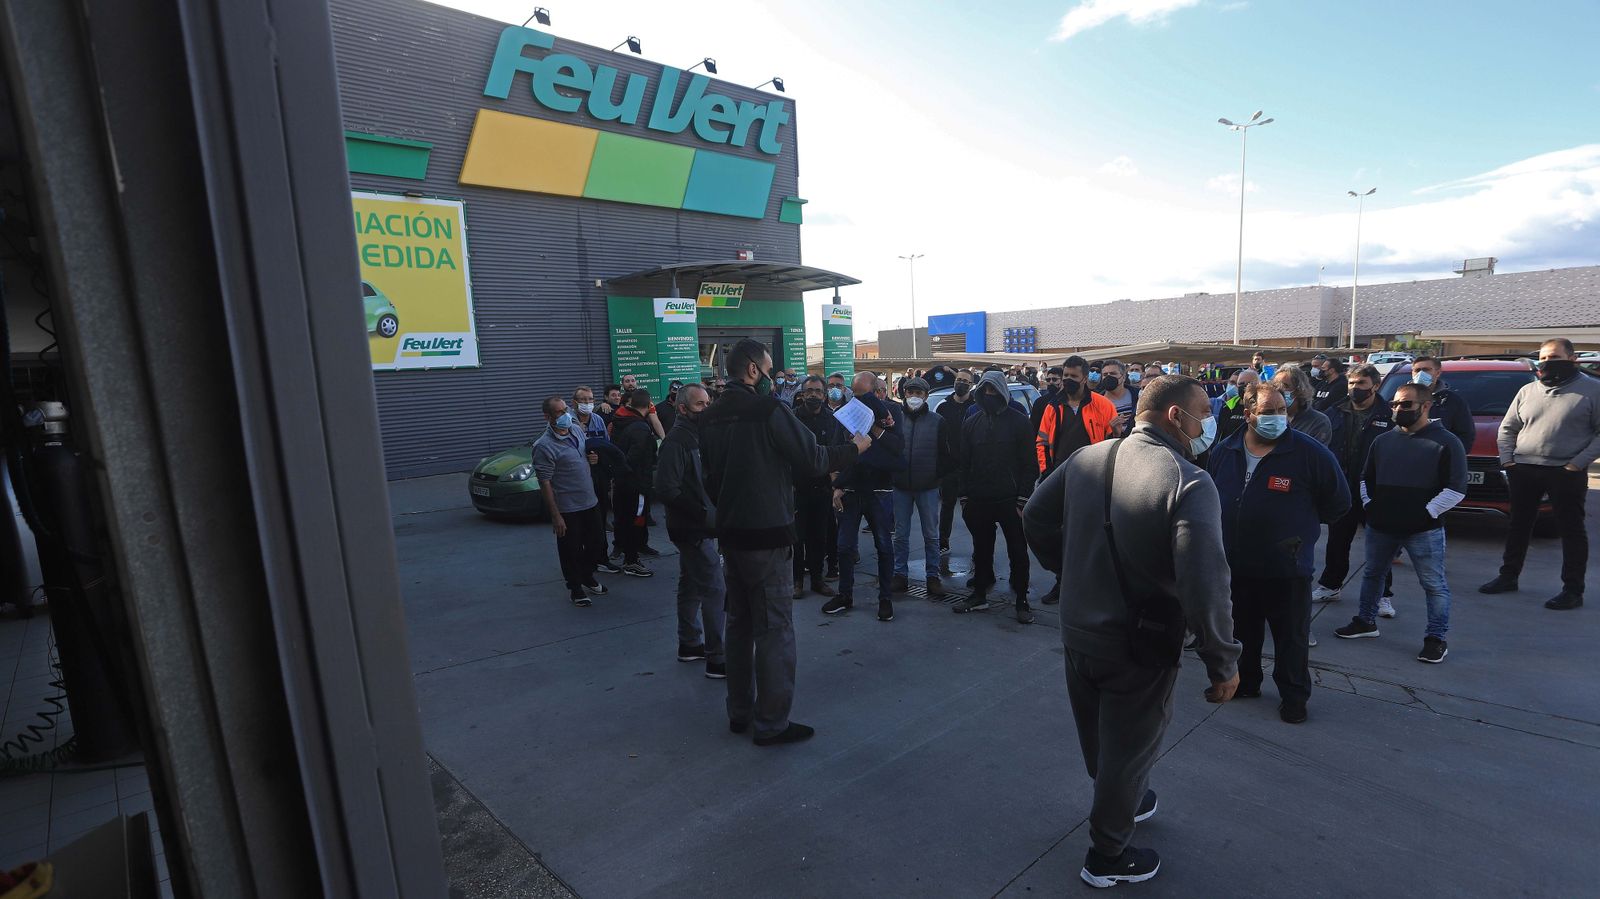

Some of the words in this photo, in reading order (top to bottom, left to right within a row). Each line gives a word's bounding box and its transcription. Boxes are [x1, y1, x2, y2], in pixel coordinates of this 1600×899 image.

[484, 26, 648, 125] Feu
[648, 65, 789, 154] Vert
[356, 211, 452, 239] IACIÓN
[362, 244, 456, 270] EDIDA
[701, 284, 720, 295] Feu
[720, 285, 743, 296] Vert
[665, 302, 681, 310] Feu
[681, 302, 695, 310] Vert
[403, 338, 432, 350] Feu
[432, 338, 464, 349] Vert
